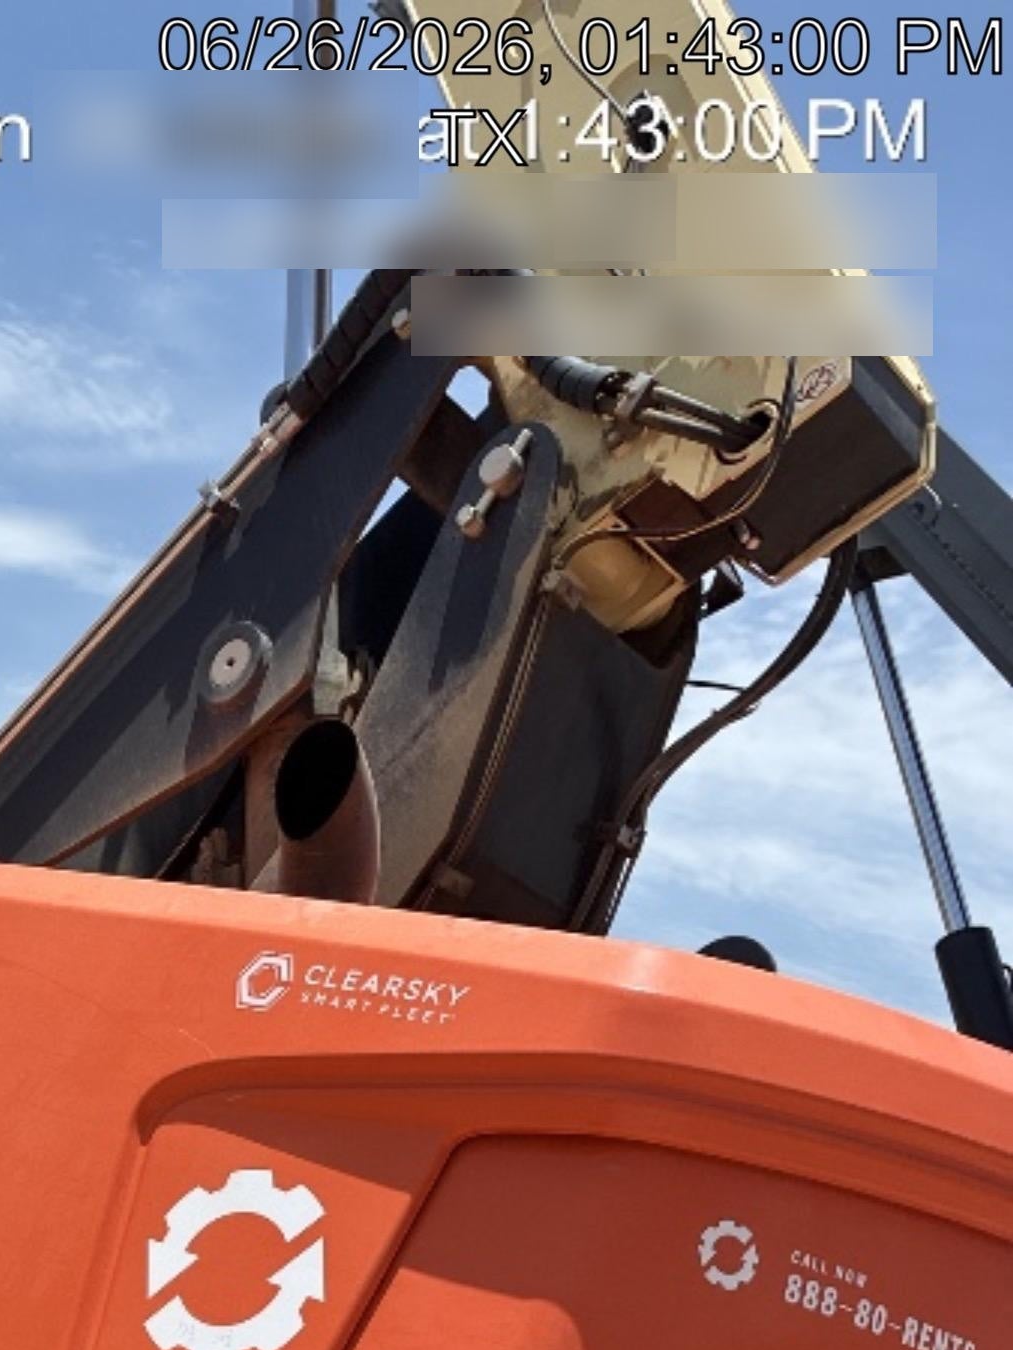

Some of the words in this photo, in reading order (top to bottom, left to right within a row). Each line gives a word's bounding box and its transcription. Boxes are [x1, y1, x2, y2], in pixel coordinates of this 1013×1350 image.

[303, 964, 471, 1007] CLEARSKY
[300, 991, 372, 1013] SMART
[379, 1005, 456, 1025] FLEET
[790, 1250, 828, 1276] CALL
[835, 1264, 868, 1289] NOW
